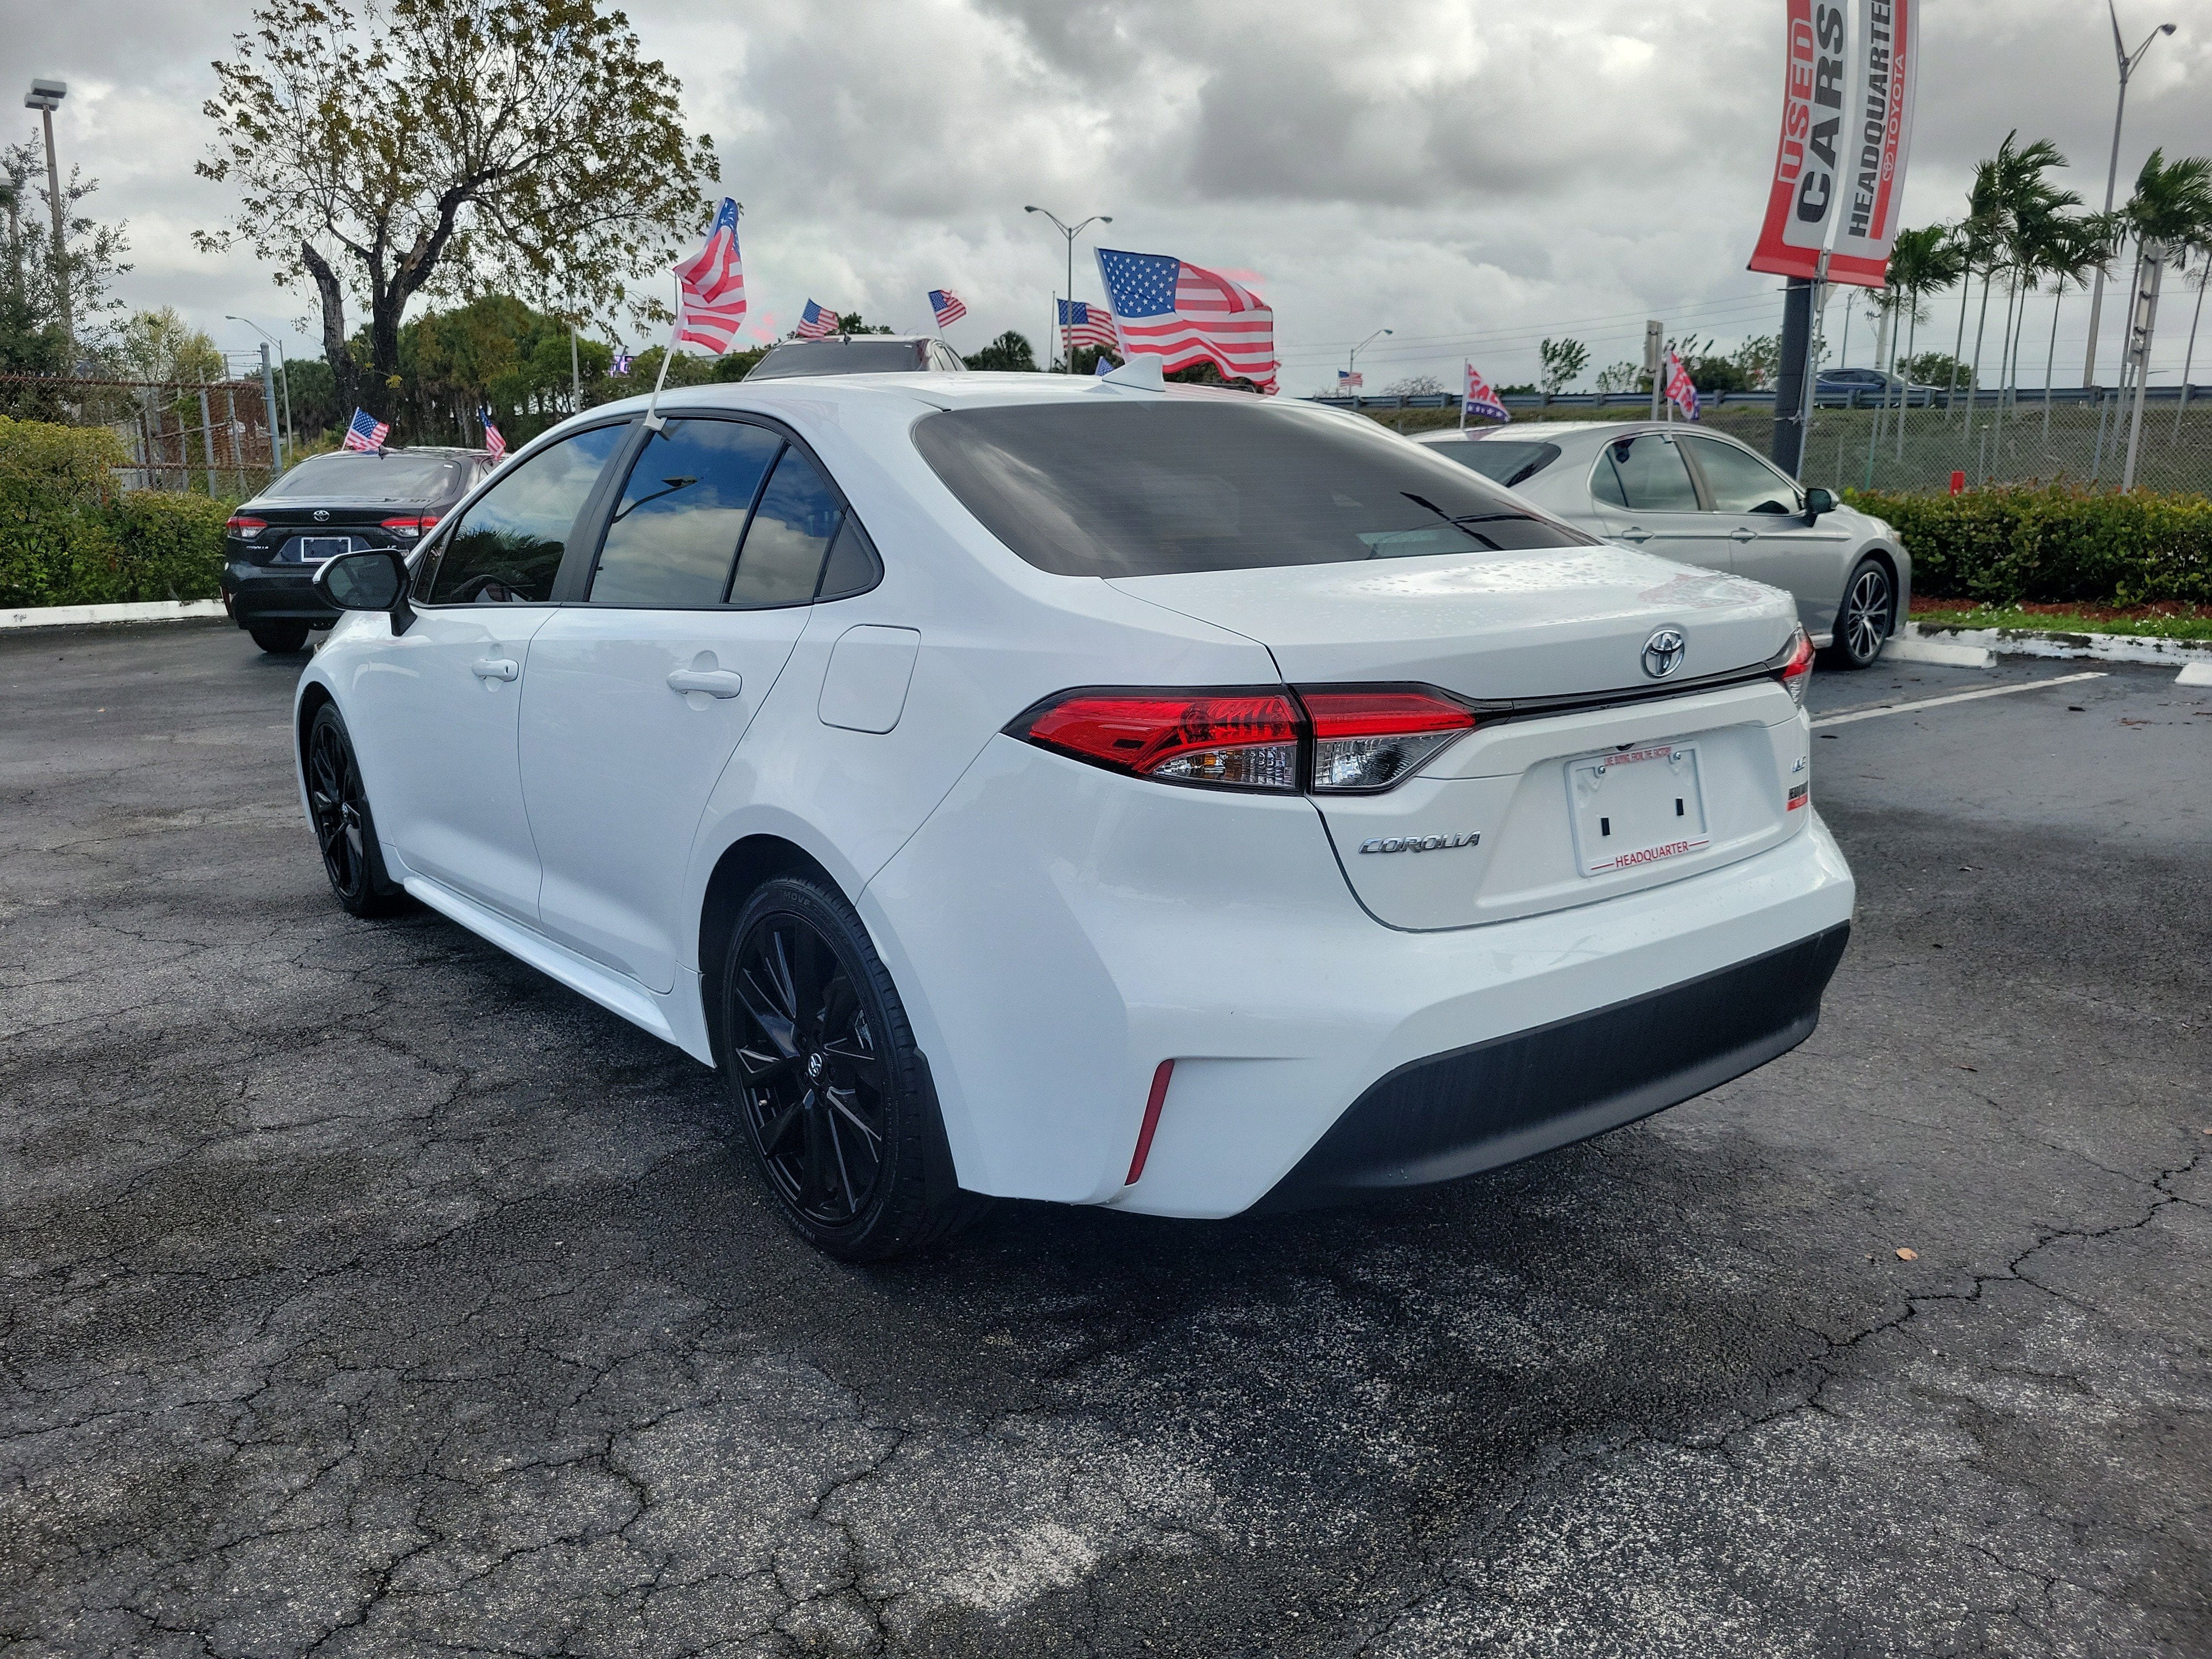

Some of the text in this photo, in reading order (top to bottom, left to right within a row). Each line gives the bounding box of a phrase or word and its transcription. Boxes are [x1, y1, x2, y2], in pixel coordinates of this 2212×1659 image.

[1779, 19, 1814, 182] USED
[1797, 4, 1843, 223] CARS
[1848, 0, 1891, 238] HEADQUARTE
[1887, 54, 1904, 149] TOYOTA
[1359, 830, 1481, 853] COROLLA
[1615, 841, 1689, 867] HEADQUARTER
